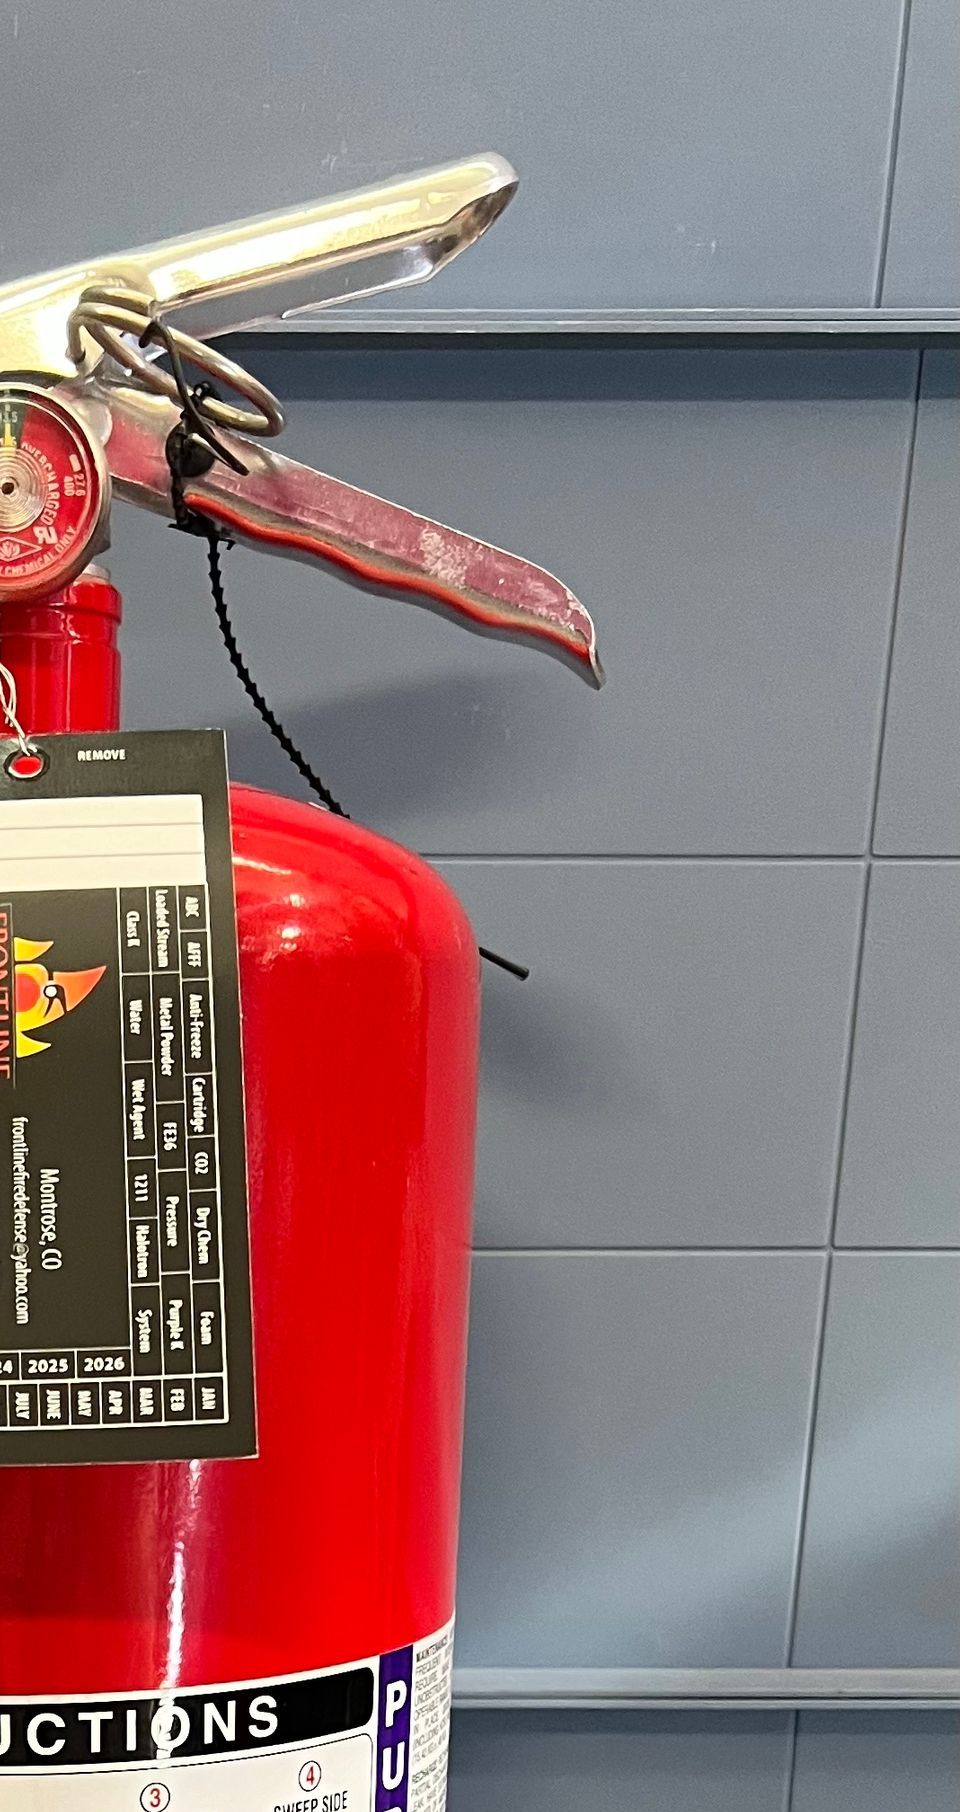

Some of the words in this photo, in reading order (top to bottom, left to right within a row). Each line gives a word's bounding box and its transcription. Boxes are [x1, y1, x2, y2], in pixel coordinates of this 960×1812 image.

[77, 750, 126, 762] REMOVE
[155, 889, 169, 927] Loaded
[185, 896, 200, 917] ABC
[126, 911, 141, 938] Class
[127, 938, 140, 947] K
[157, 929, 171, 967] Stream
[187, 941, 201, 967] AFFF
[129, 999, 142, 1034] Water
[160, 997, 173, 1030] Metal
[189, 993, 203, 1059] Anti-Freeze
[160, 1032, 174, 1076] Powder
[131, 1079, 146, 1102] Wet
[190, 1077, 207, 1133] Cartridge
[129, 1104, 146, 1140] Agent
[163, 1122, 177, 1150] FE36
[194, 1152, 209, 1174] CO2
[134, 1174, 148, 1202] 1211
[10, 1117, 32, 1324] frontlinefiredefense@yahoo.com
[38, 1168, 61, 1246] Montrose,
[194, 1207, 210, 1229] Dry
[166, 1196, 180, 1247] Pressure
[41, 1248, 62, 1270] CO
[135, 1225, 150, 1278] Halotron
[197, 1229, 211, 1264] Chem
[136, 1310, 151, 1353] System
[167, 1299, 183, 1340] Purple
[200, 1311, 214, 1345] Foam
[171, 1340, 184, 1350] K
[27, 1359, 69, 1374] 2025
[83, 1357, 125, 1372] 2026
[15, 1391, 30, 1419] JULY
[46, 1389, 61, 1420] JUNE
[77, 1390, 92, 1417] MAY
[108, 1390, 123, 1415] APR
[139, 1387, 153, 1416] MAR
[170, 1388, 184, 1412] FEB
[201, 1387, 215, 1410] JAN
